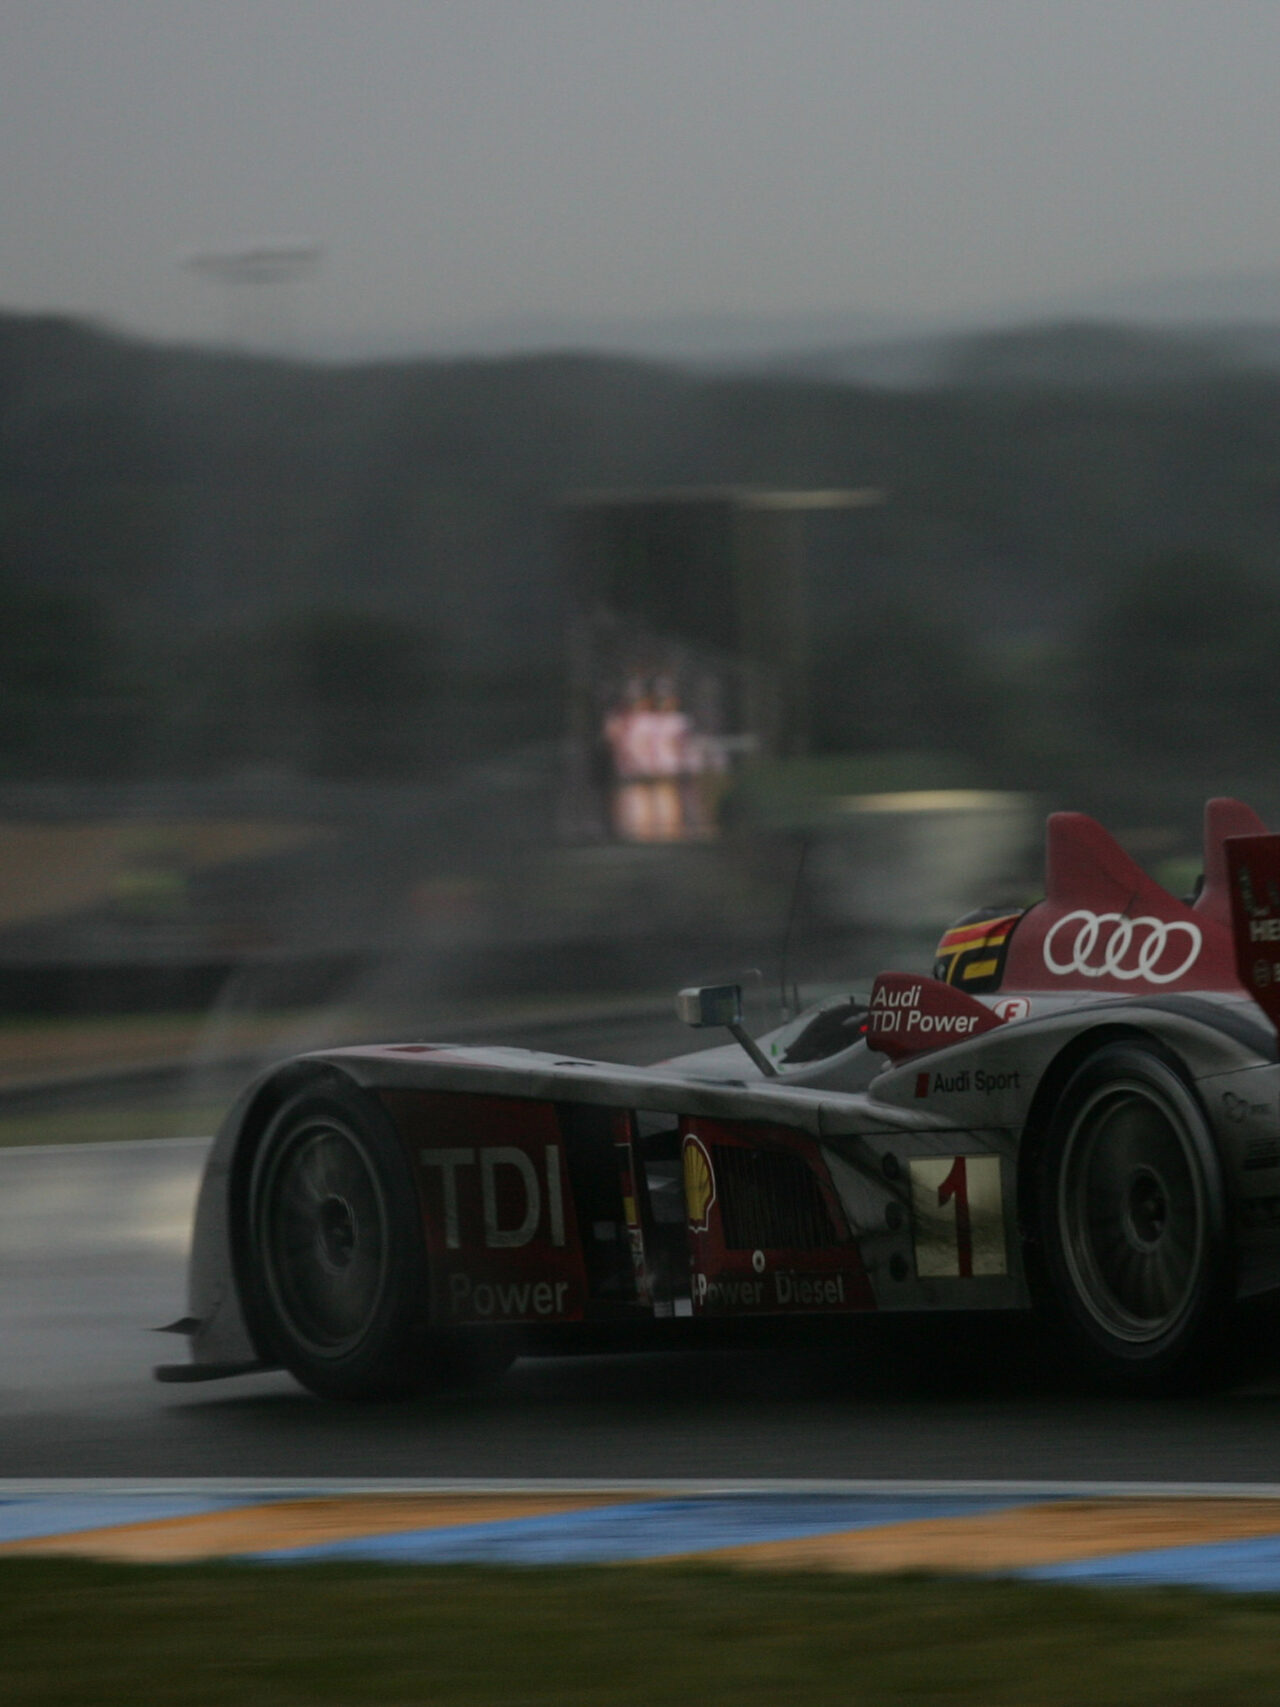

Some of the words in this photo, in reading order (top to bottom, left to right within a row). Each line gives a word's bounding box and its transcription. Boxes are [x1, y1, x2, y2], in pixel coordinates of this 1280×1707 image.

[873, 984, 922, 1008] Audi
[870, 1010, 902, 1033] TDI
[906, 1010, 979, 1033] Power
[934, 1072, 970, 1092] Audi
[975, 1070, 1020, 1095] Sport
[418, 1144, 566, 1249] TDI
[938, 1156, 973, 1278] 1
[450, 1272, 568, 1316] Power
[775, 1269, 845, 1304] Diesel
